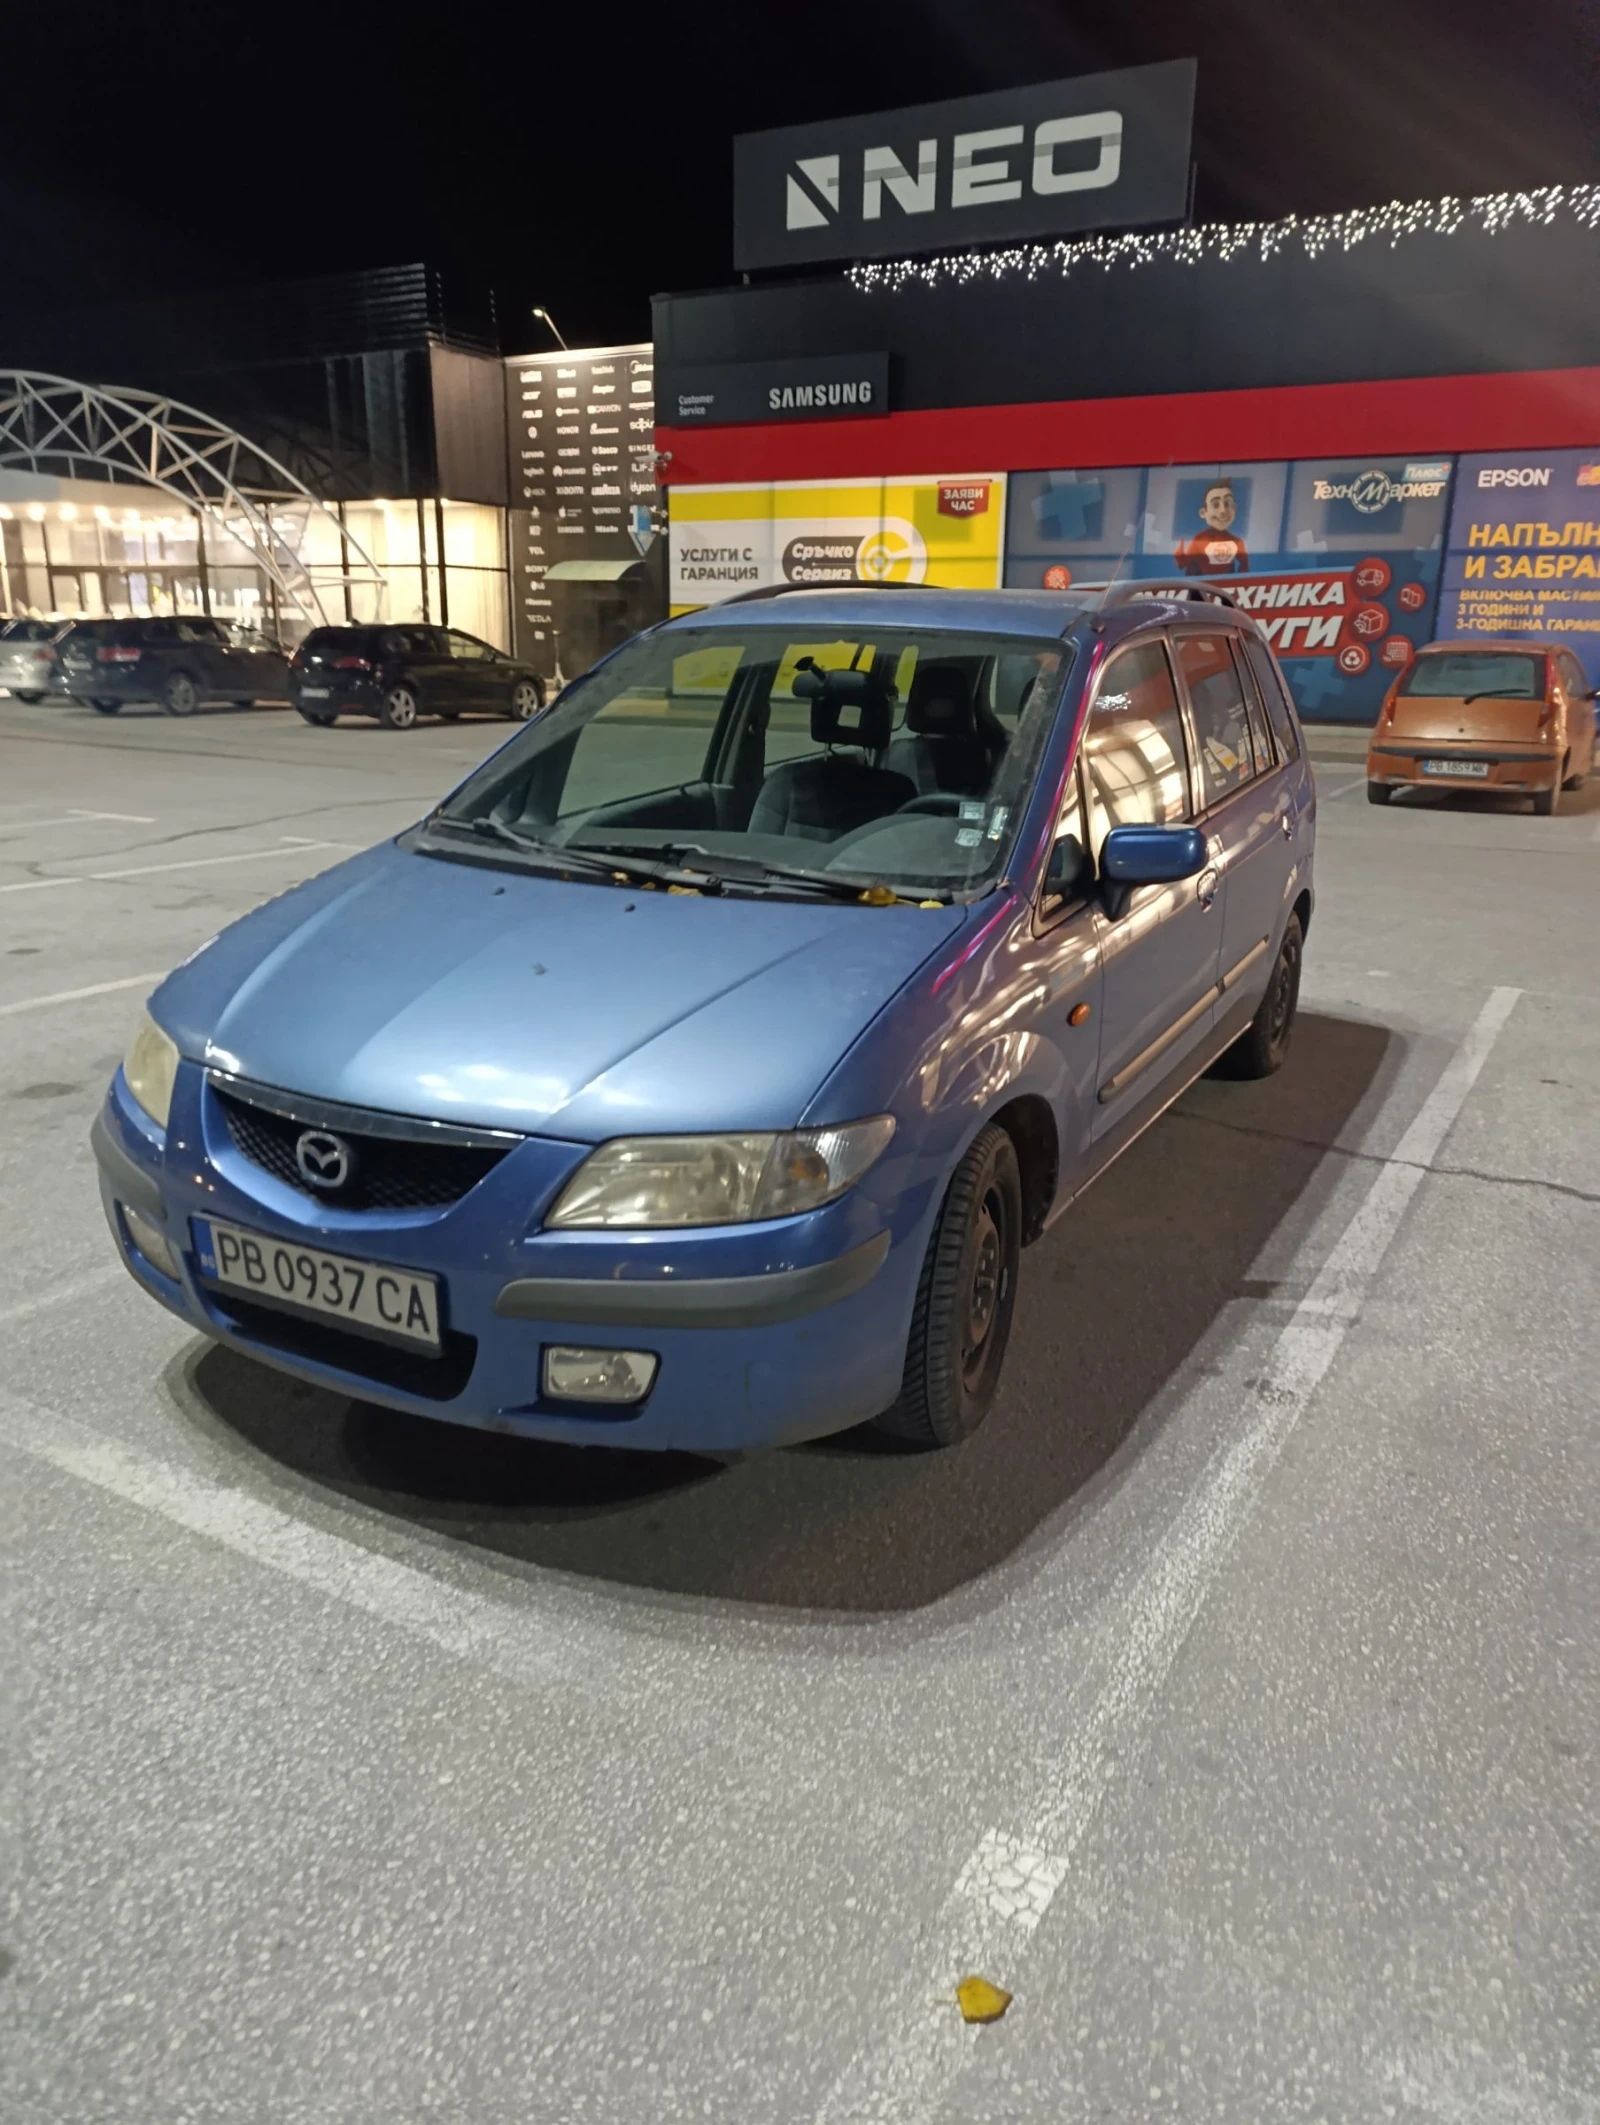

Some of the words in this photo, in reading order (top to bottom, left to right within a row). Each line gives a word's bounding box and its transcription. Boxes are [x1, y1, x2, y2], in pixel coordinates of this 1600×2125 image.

[863, 111, 1122, 220] NEO
[679, 395, 714, 405] Customer
[769, 382, 871, 410] SAMSUNG
[679, 406, 706, 416] Service
[1478, 468, 1550, 488] EPSON
[944, 488, 984, 500] ЗАЯВИ
[951, 500, 975, 511] ЧАС
[680, 548, 738, 562] УСЛУГИ
[743, 548, 752, 561] С
[791, 543, 854, 560] Сръчко
[681, 567, 758, 581] ГАРАНЦИЯ
[791, 566, 852, 581] Сервиз
[1464, 555, 1486, 578] И
[1493, 555, 1600, 579] ЗАБРА
[1460, 590, 1535, 601] ВКЛЮЧВА
[1469, 604, 1530, 617] ГОДИНИ
[1533, 604, 1544, 615] И
[1456, 618, 1543, 631] 3-ГОДИШНА
[218, 1231, 266, 1284] PB
[274, 1249, 365, 1312] 0937
[376, 1276, 430, 1334] CA
